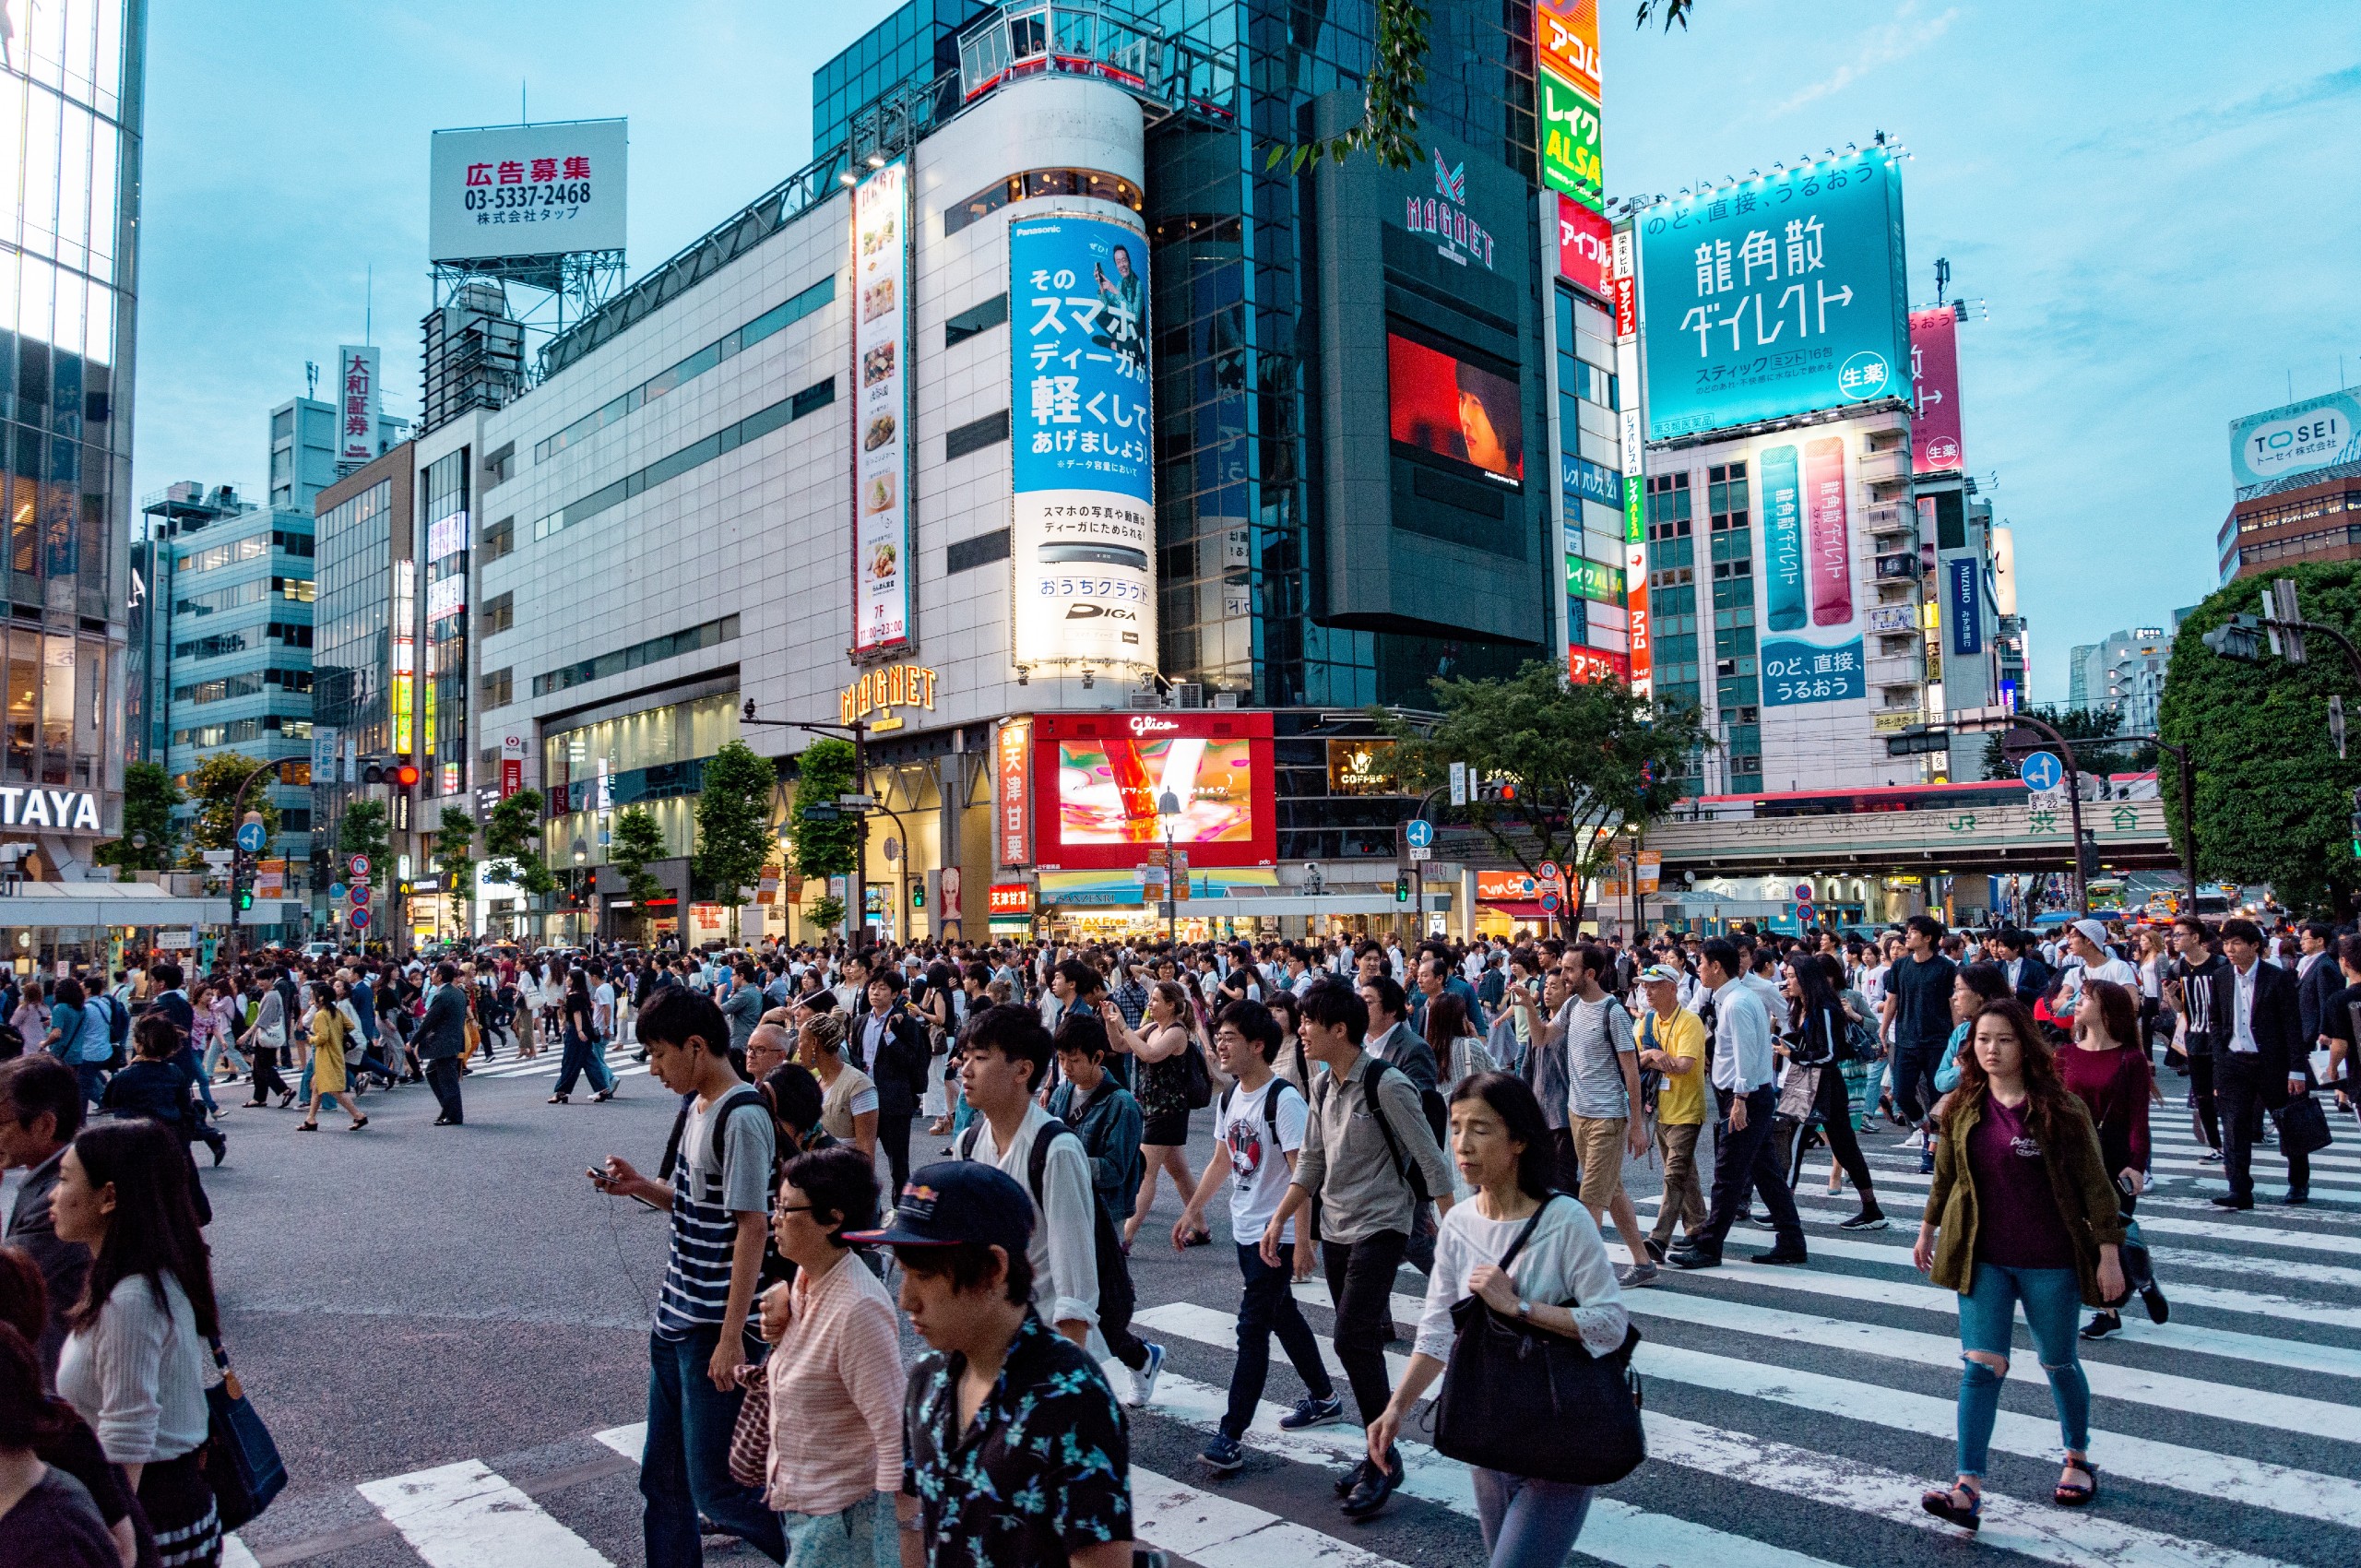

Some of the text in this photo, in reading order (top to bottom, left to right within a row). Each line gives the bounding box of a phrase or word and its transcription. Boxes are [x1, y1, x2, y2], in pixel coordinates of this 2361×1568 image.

[1548, 18, 1603, 82] アコム
[1546, 86, 1598, 146] レイク
[466, 156, 591, 187] 広告募集
[1547, 129, 1602, 188] ALSA
[465, 183, 591, 210] 03-5337-2468
[1647, 161, 1873, 236] のど、直接、うるおう
[477, 206, 579, 225] 株式会社タップ
[1016, 225, 1061, 237] Panasonic
[1407, 196, 1494, 270] MAGNET
[1560, 220, 1611, 267] アイフル
[1694, 215, 1825, 297] 龍角散
[1030, 268, 1076, 291] その
[1619, 291, 1633, 336] アイフル
[1679, 279, 1854, 358] ダイレクト
[1030, 339, 1146, 384] ディーガが
[1695, 347, 1833, 385] スティック ミント 16包
[1842, 363, 1887, 389] 生薬
[346, 354, 371, 437] 大和証券
[1031, 374, 1146, 436] 軽くして
[1653, 415, 1714, 436] 第3類医薬品
[2255, 419, 2336, 453] TOSEI
[1031, 429, 1148, 465] あげましょう!
[1928, 443, 1957, 459] 生薬
[2257, 438, 2337, 466] トーセイ株式会社
[1564, 465, 1618, 500] レオパレス21
[1044, 505, 1145, 527] スマホの写真や動画は
[1044, 520, 1146, 542] ディーガにためられる!
[1821, 481, 1844, 579] 龍角散ダイレクト
[1775, 488, 1798, 585] 龍角散ダイレクト
[1040, 579, 1148, 603] おうちクラウド
[1961, 565, 1971, 604] MIZUHO
[875, 604, 884, 619] 7F
[1065, 602, 1137, 622] DIGA
[1632, 610, 1646, 649] アコム
[1767, 652, 1863, 676] のど、直接、
[841, 665, 936, 726] MAGNET
[1777, 677, 1849, 700] うるおう
[1130, 716, 1180, 736] Glico
[0, 787, 101, 830] TAYA
[1004, 747, 1023, 861] 天津甘栗
[1949, 815, 1977, 831] JR
[991, 890, 1027, 907] 天津甘栗
[1058, 893, 1116, 903] SANZENRI
[1077, 916, 1128, 926] TAX Free
